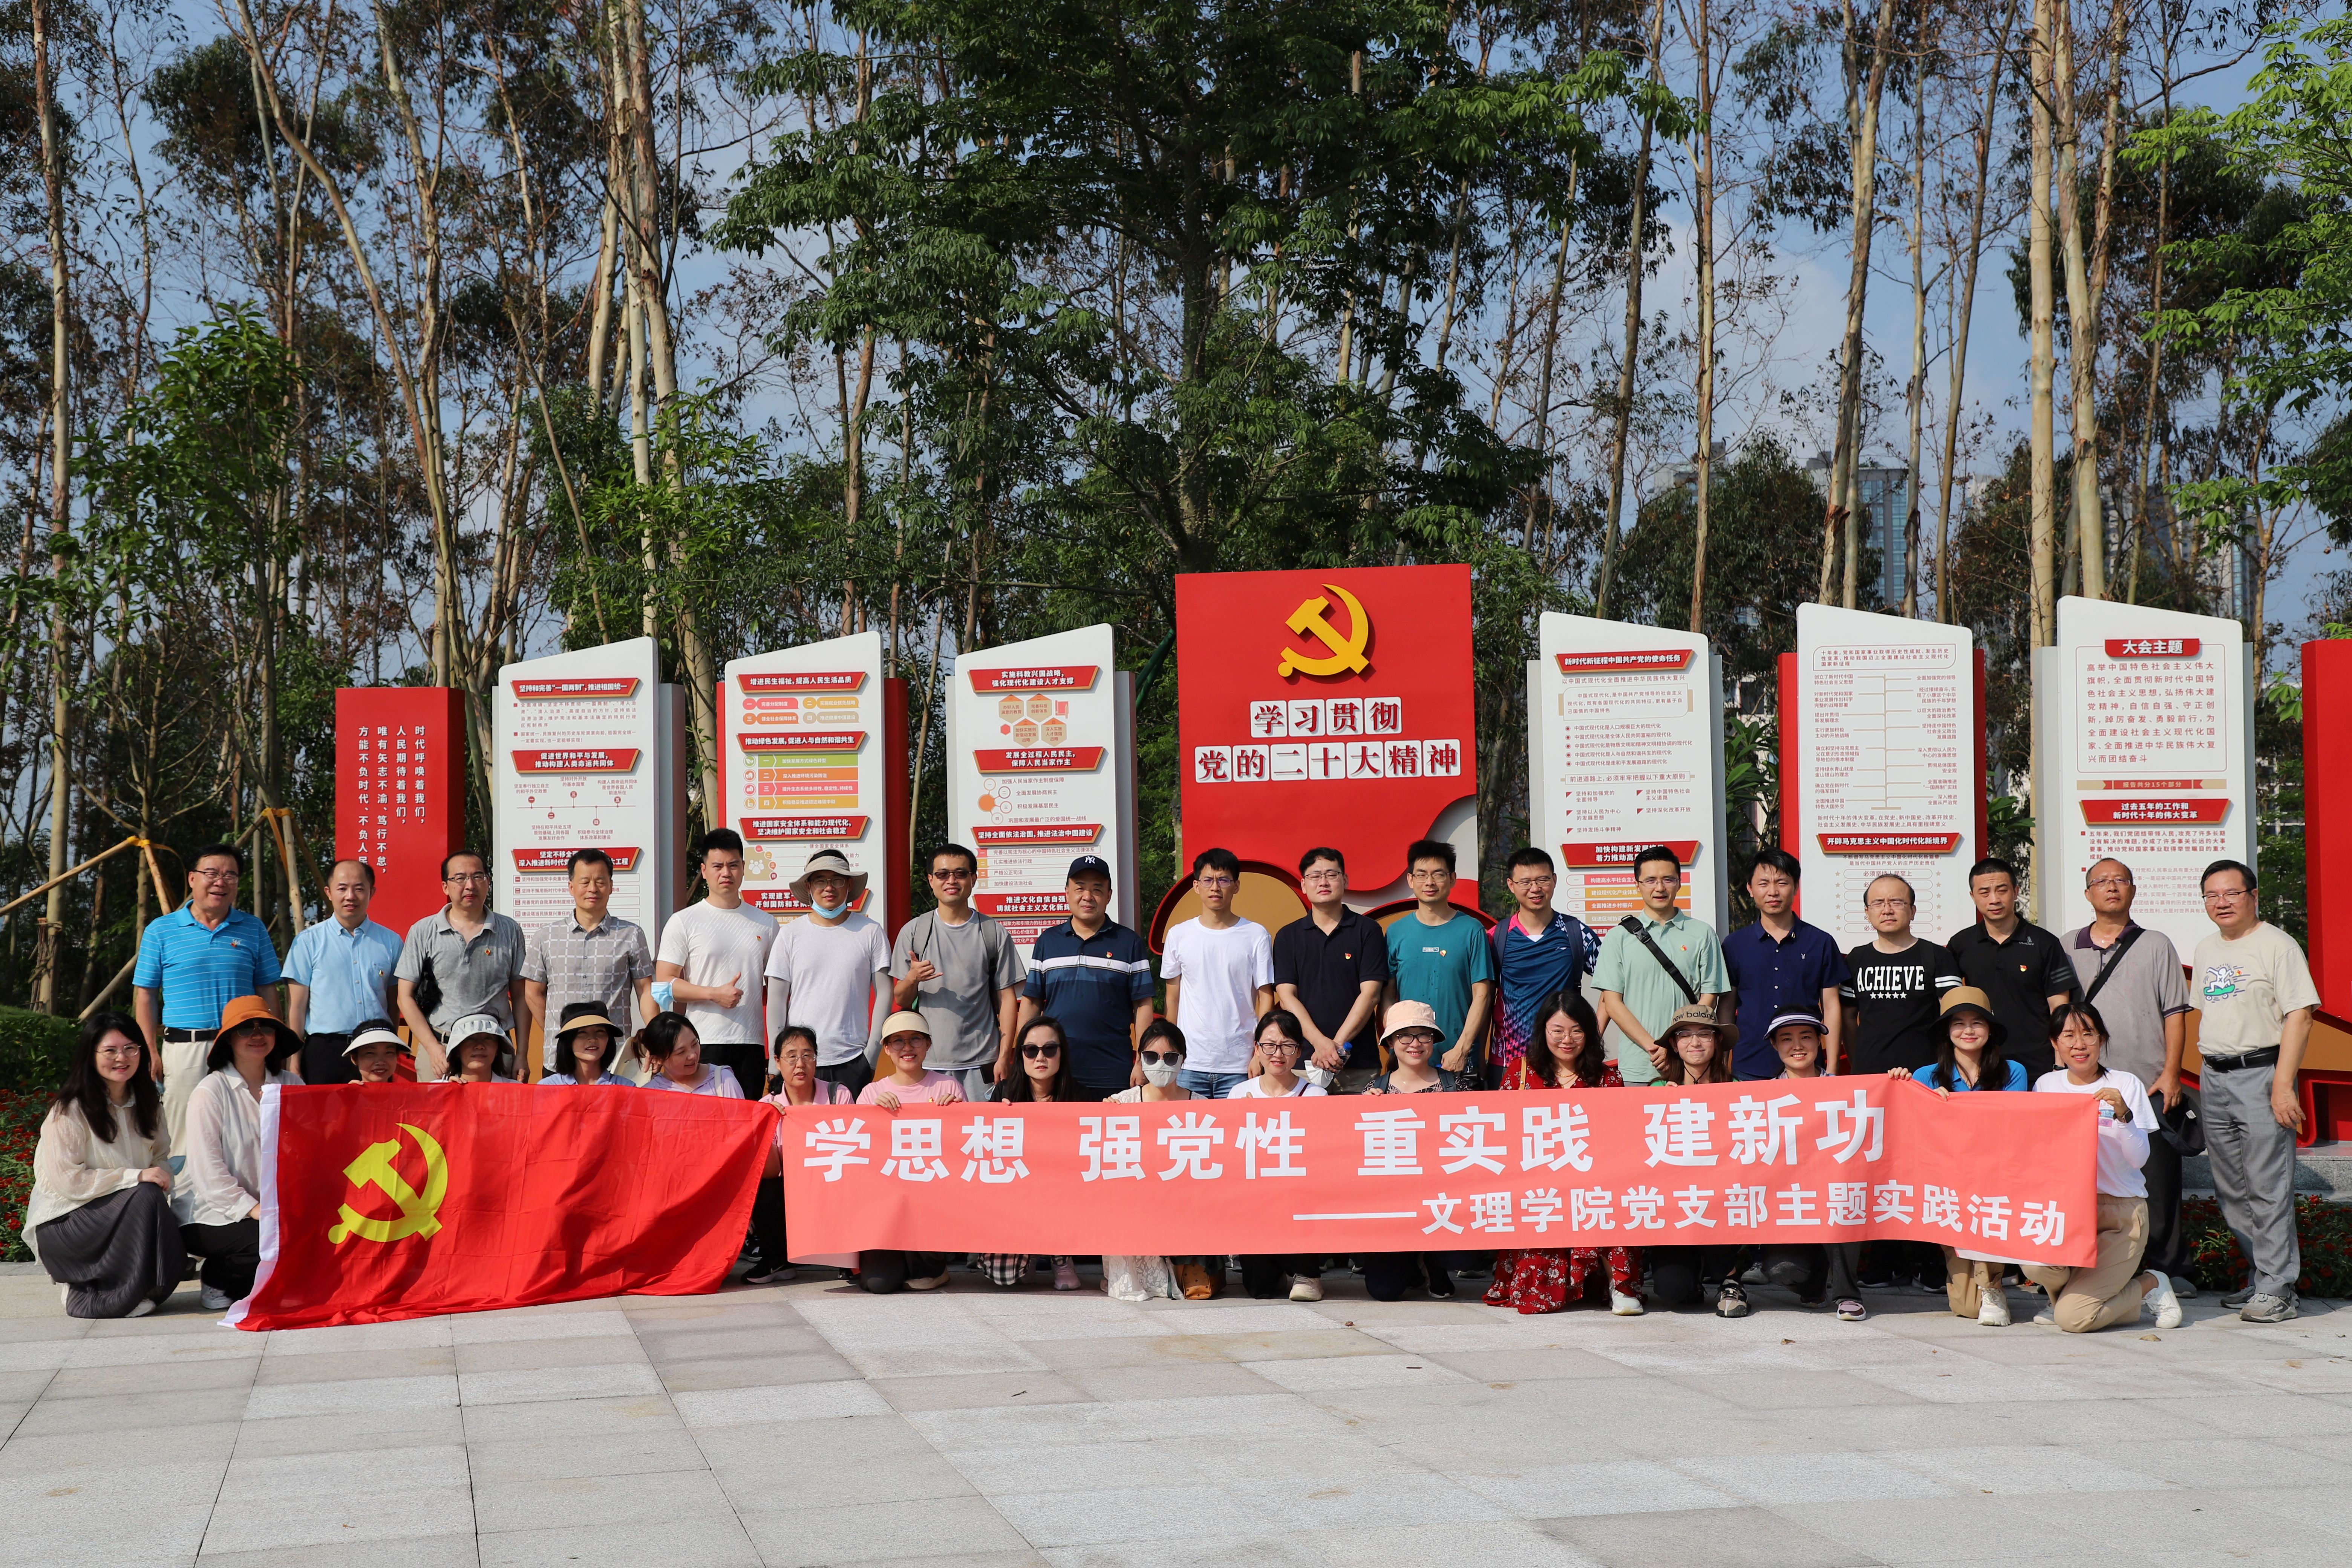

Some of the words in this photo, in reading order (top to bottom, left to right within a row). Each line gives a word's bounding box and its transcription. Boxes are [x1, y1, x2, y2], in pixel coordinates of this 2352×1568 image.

[2122, 640, 2183, 654] 大会主题
[1565, 654, 1681, 666] 新时代新征程中国共产党的使命任务
[2087, 662, 2214, 671] 高举中国特色社会主义伟大
[992, 678, 1074, 687] 强化现代化建设人才支撑
[1562, 675, 1685, 684] 以中国式现代化全面推进中华民族伟大复兴
[1254, 701, 1399, 733] 学习贯彻
[2088, 728, 2215, 737] 全面建设社会主义现代化国
[1574, 740, 1692, 749] 中国式现代化是物质文明和精神文明相协调的现代化
[1006, 750, 1075, 759] 发展全过程人民民主，
[2088, 755, 2147, 763] 兴而团结奋斗
[535, 760, 614, 768] 推动构建人类命运共同体
[1012, 758, 1071, 767] 保障人民当家作主
[1199, 744, 1456, 780] 党的二十大精神
[396, 725, 406, 824] 人民期待着我们，
[415, 726, 425, 824] 时代呼唤着我们，
[758, 827, 846, 836] 坚决维护国家安全和社会稳定
[1827, 837, 1948, 845] 开辟马克思主义中国化时代化新境界
[1857, 966, 1925, 992] ACHIEVE
[1673, 1014, 1684, 1023] new
[803, 1116, 1031, 1184] 学思想
[1078, 1111, 1306, 1181] 强党性
[1354, 1102, 1594, 1177] 重实践
[1643, 1089, 1884, 1169] 建新功
